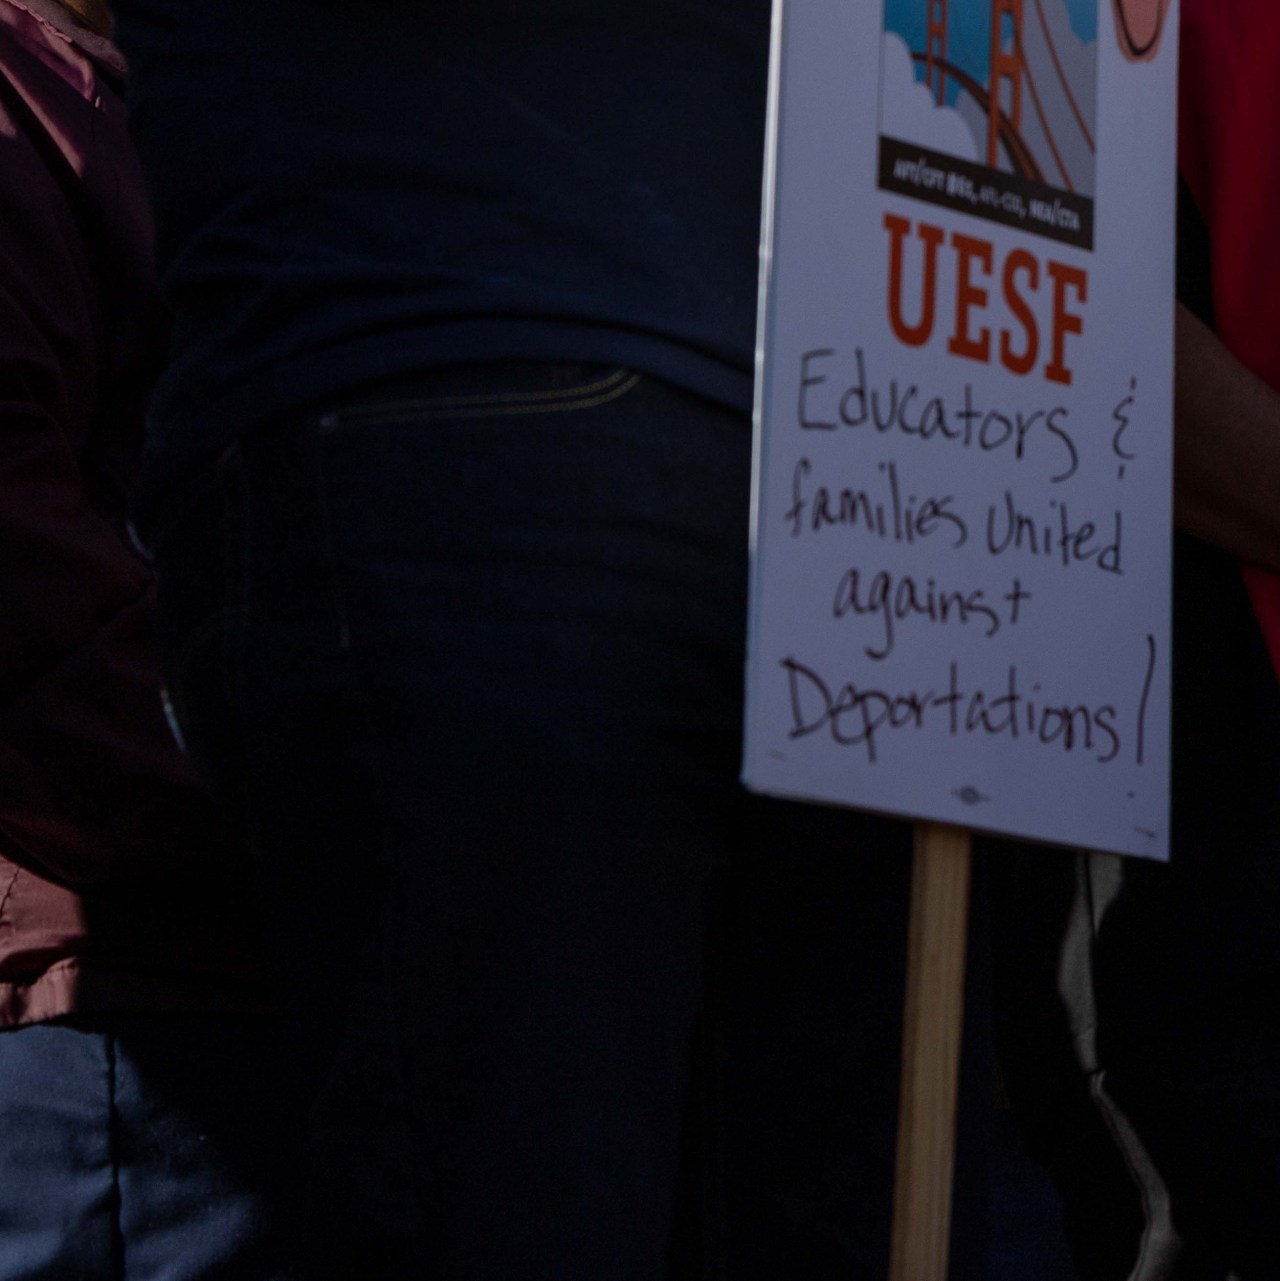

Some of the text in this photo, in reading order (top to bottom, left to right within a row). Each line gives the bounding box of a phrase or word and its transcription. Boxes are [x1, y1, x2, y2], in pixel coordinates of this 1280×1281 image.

[882, 212, 1088, 387] UESF
[797, 347, 1079, 483] Educators
[986, 489, 1126, 577] United
[832, 567, 1033, 660] against
